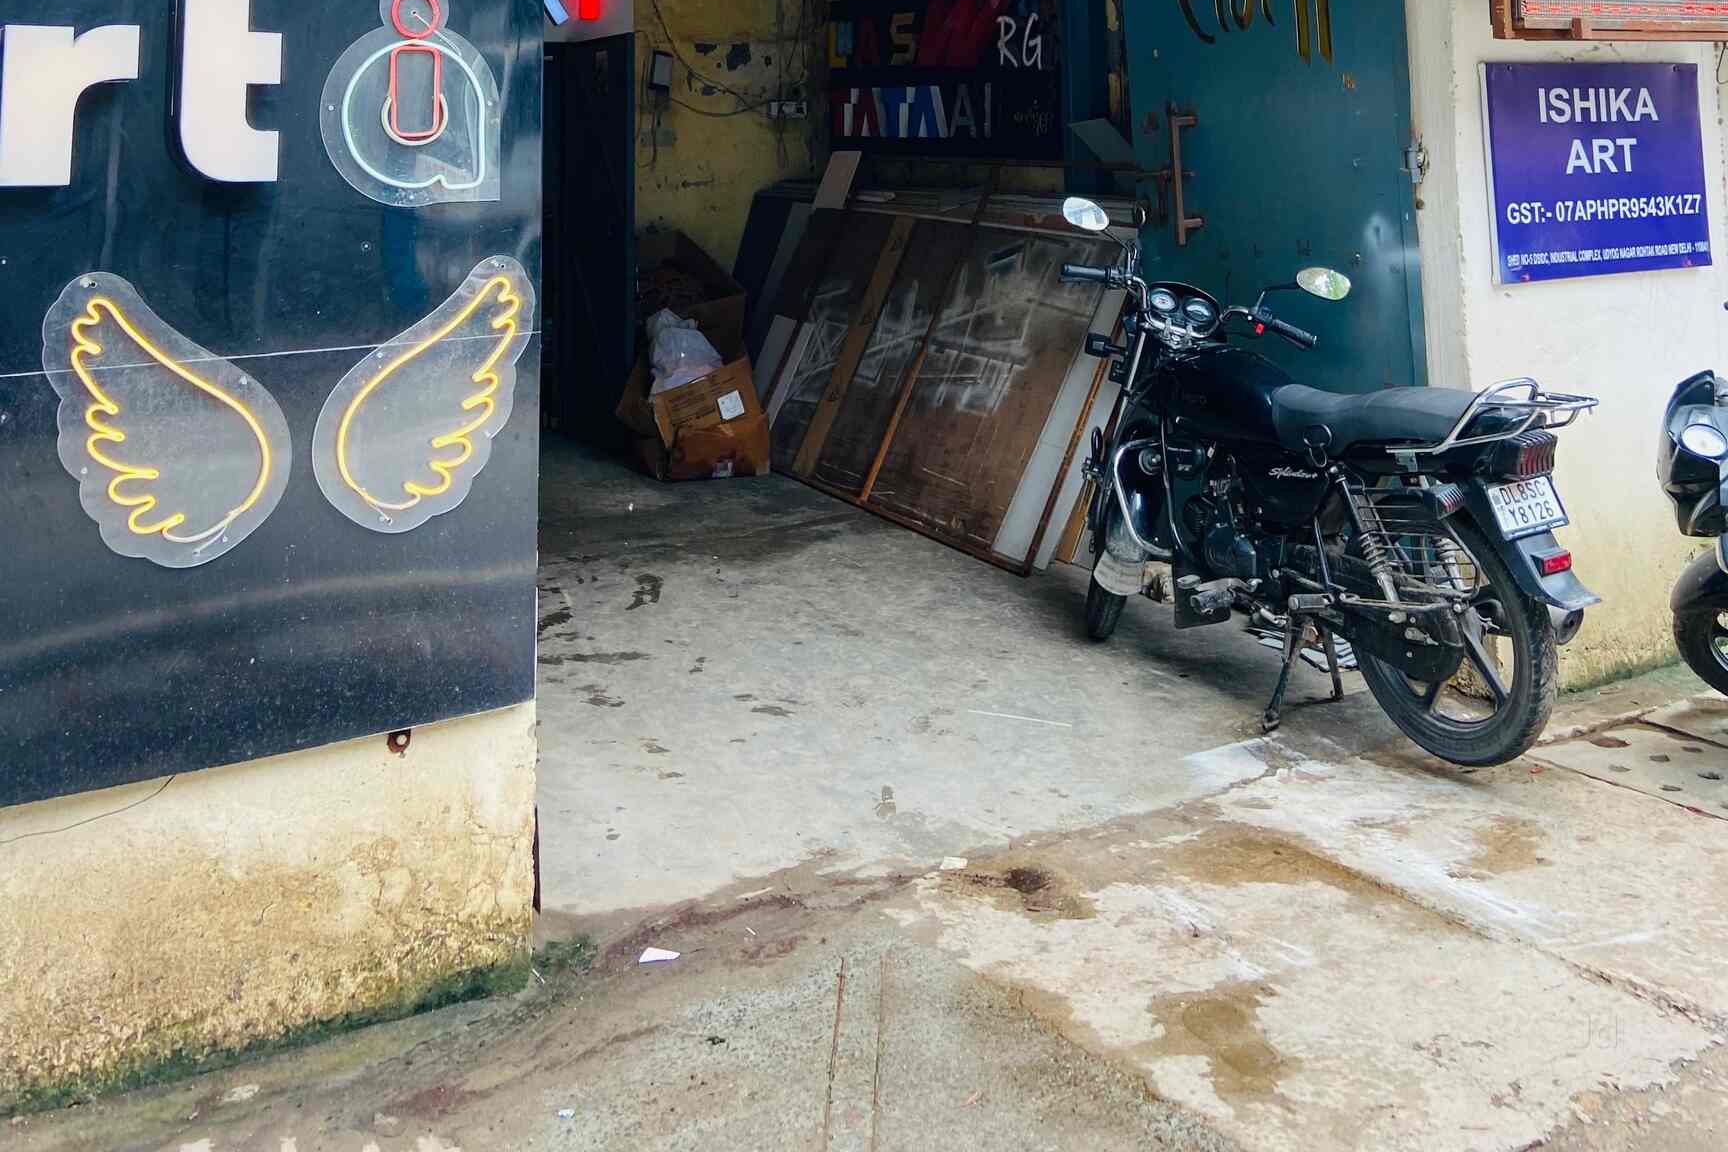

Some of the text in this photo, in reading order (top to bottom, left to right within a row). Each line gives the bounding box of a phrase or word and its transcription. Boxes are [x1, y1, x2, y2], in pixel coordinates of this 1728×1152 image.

[1538, 87, 1659, 123] ISHIKA
[1566, 138, 1637, 174] ART
[1556, 194, 1701, 222] 07APHPR9543K1Z7
[1499, 480, 1546, 506] DL8SC
[1508, 500, 1555, 527] Y8126
